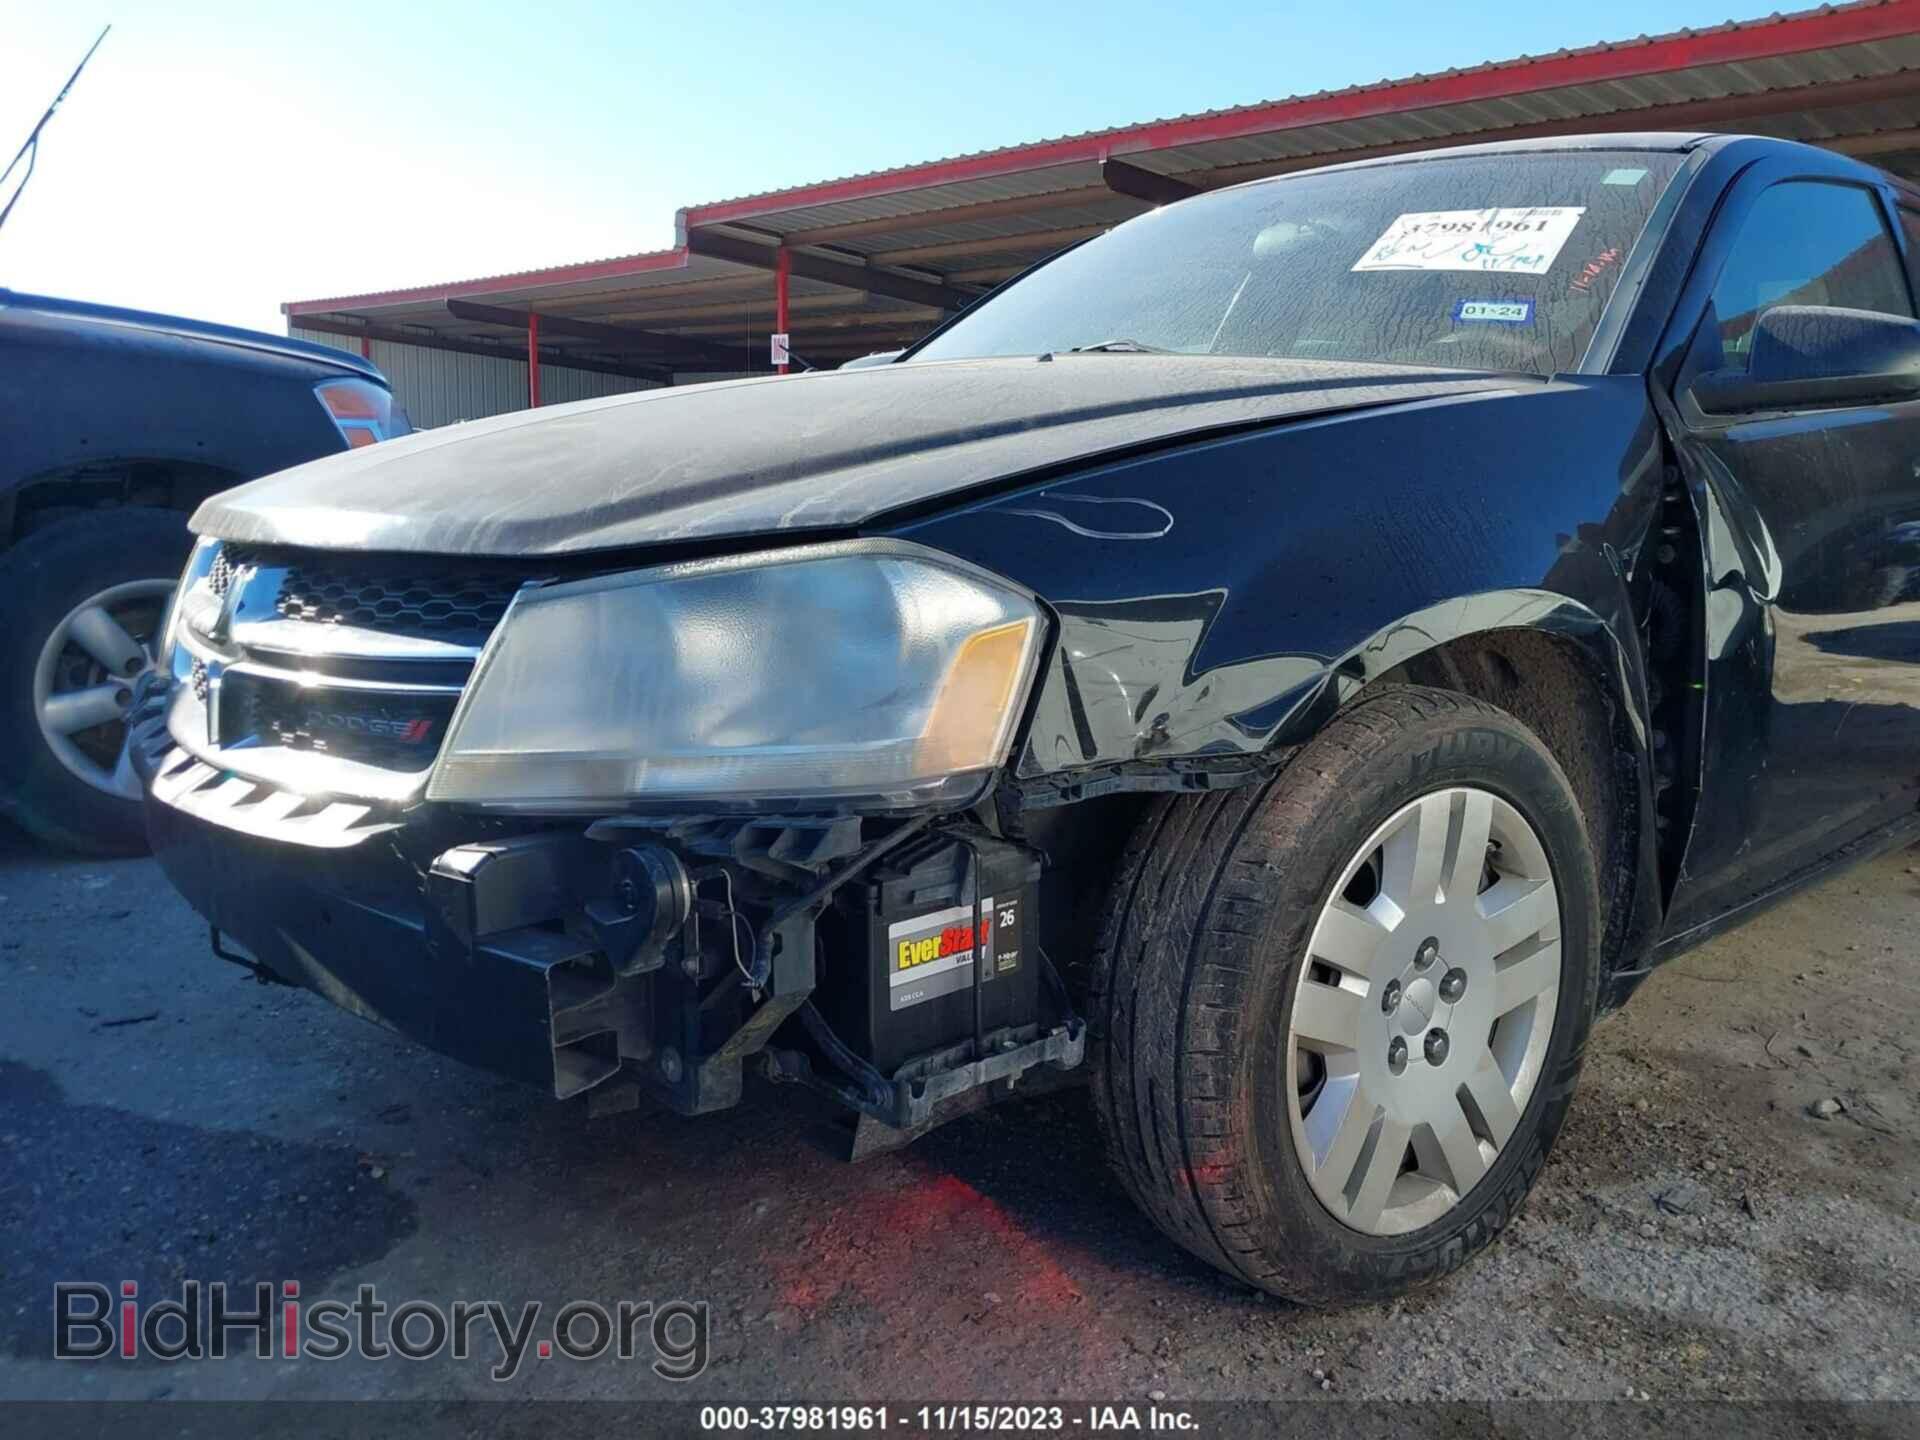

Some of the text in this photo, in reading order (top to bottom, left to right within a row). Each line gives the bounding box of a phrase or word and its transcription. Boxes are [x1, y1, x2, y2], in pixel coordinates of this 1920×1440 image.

[1464, 305, 1522, 316] 01-24
[306, 710, 411, 737] DODGE
[1000, 909, 1015, 928] 26
[898, 919, 989, 970] EverStat
